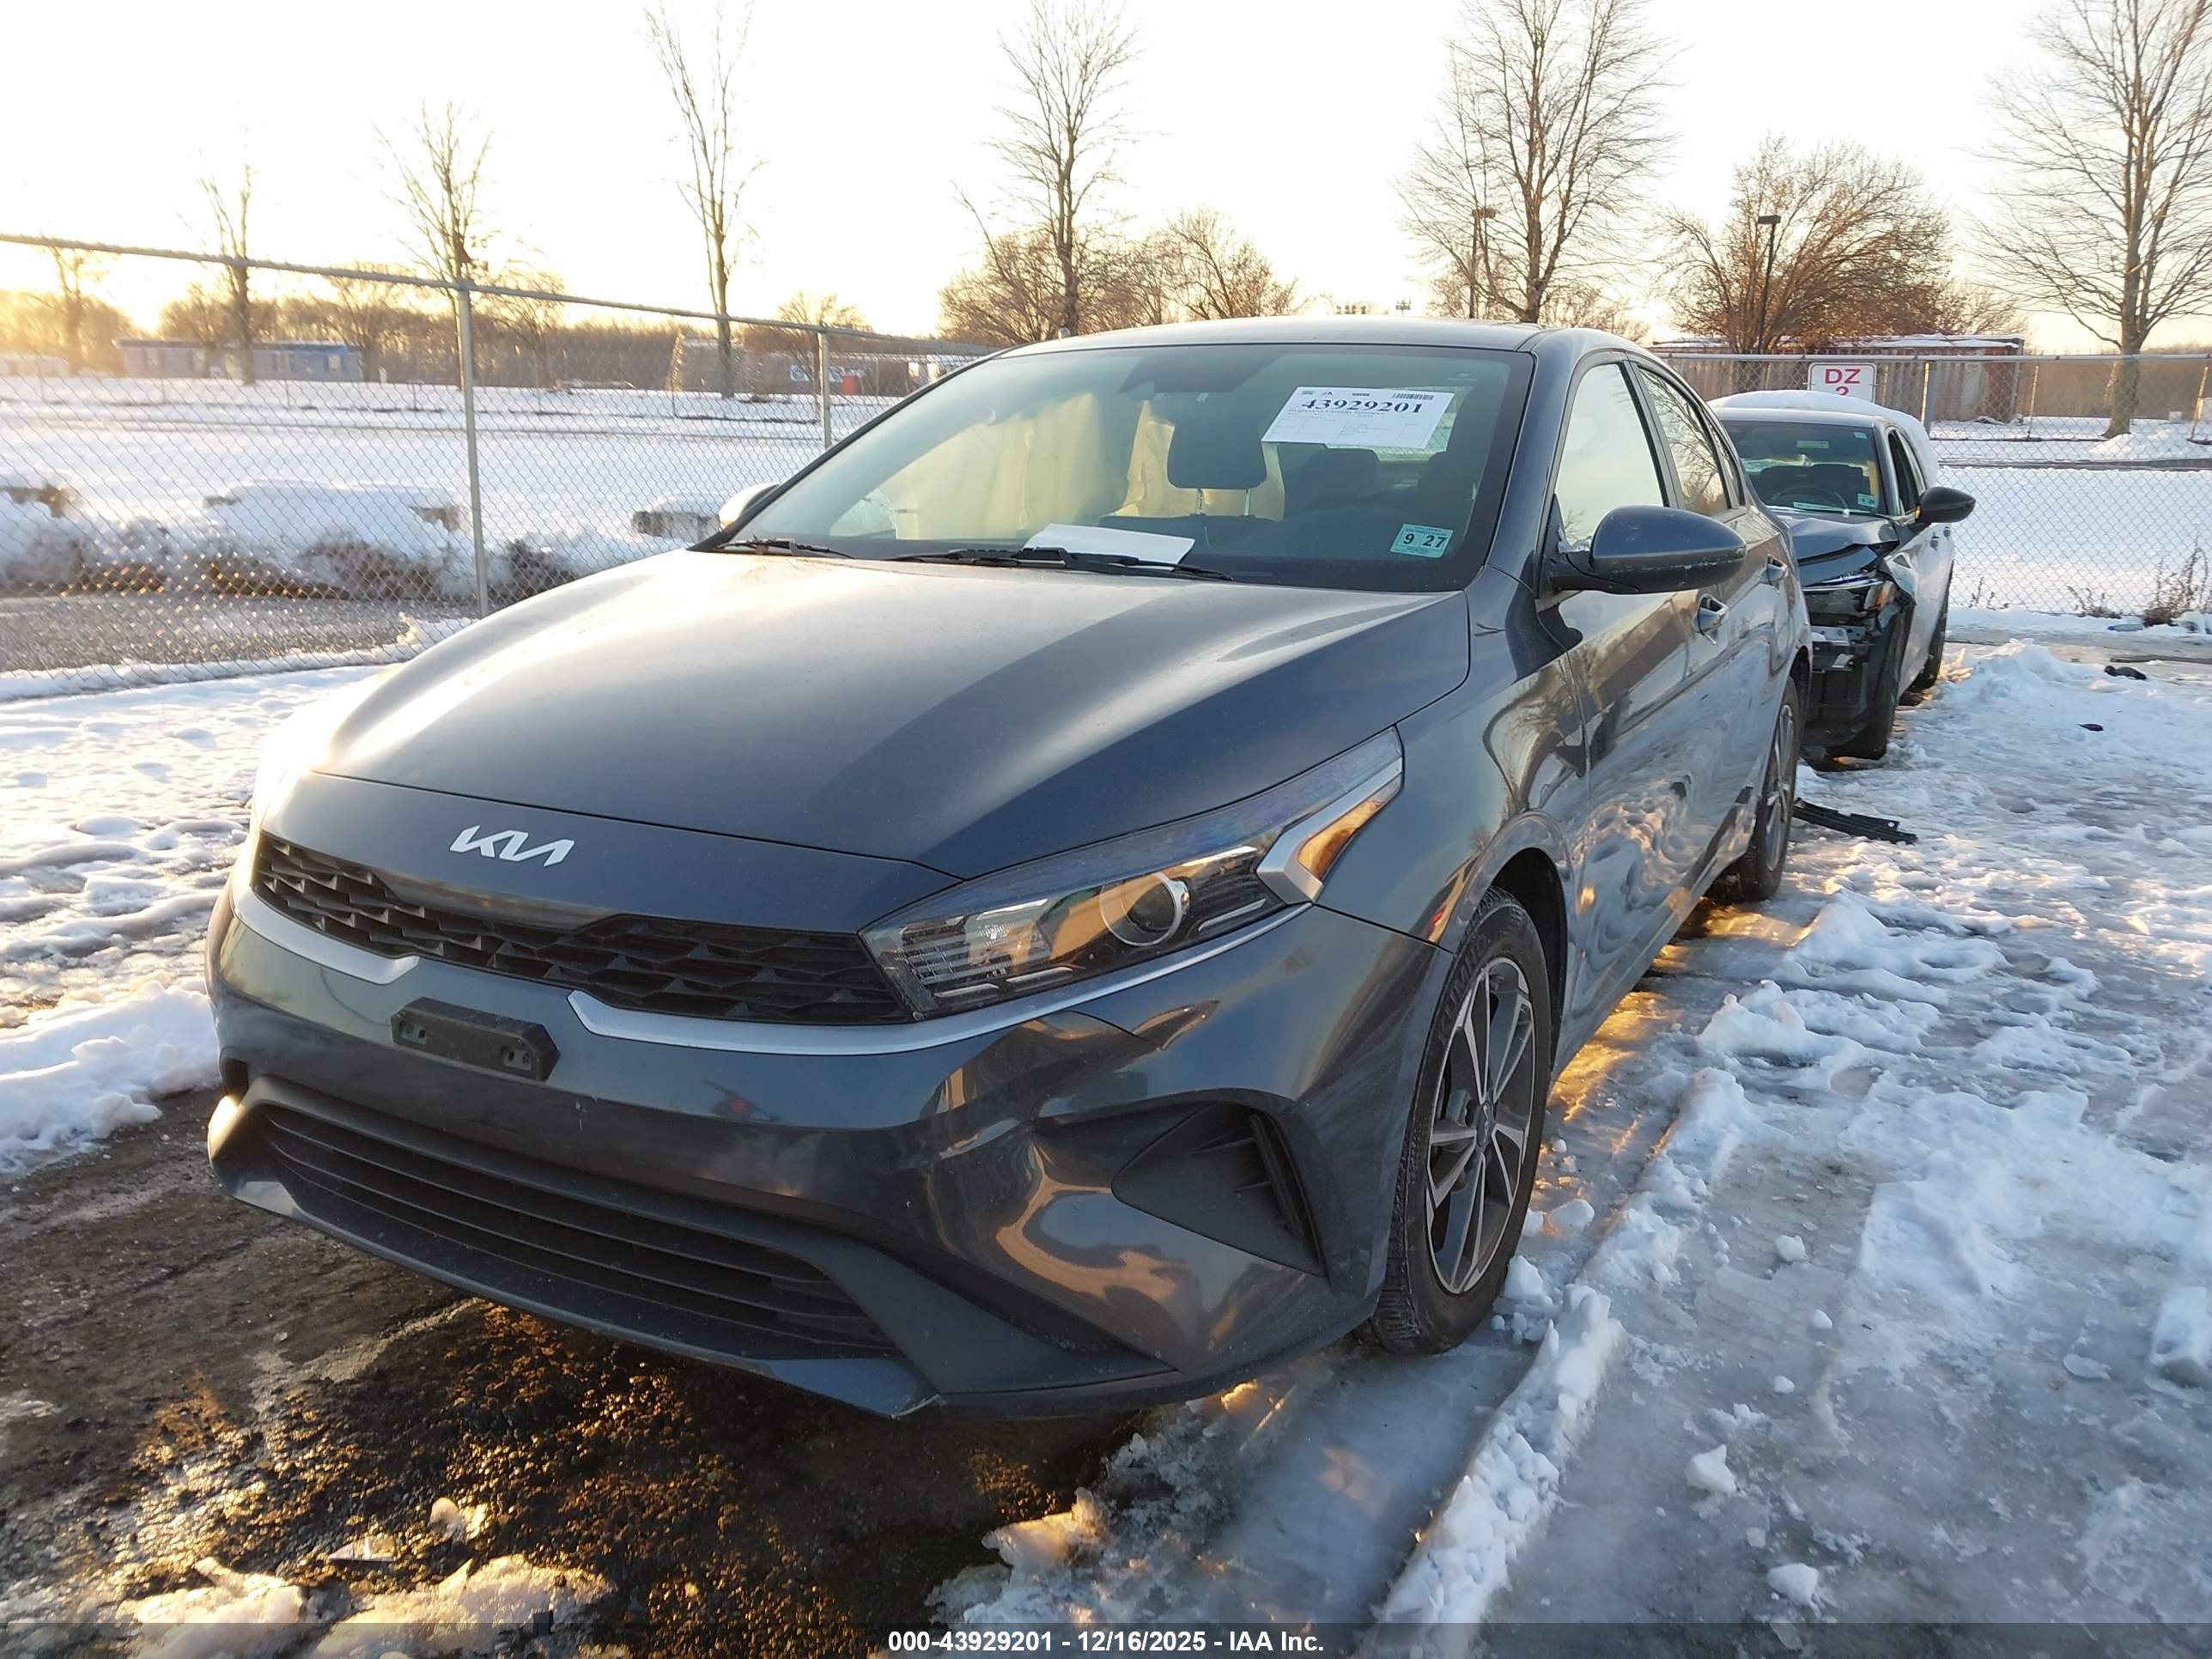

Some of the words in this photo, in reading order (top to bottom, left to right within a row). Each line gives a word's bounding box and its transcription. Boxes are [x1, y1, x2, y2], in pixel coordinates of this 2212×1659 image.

[1825, 368, 1862, 384] DZ
[1300, 398, 1423, 413] 43929201
[1403, 532, 1415, 544] 9
[1422, 535, 1448, 548] 27
[449, 824, 575, 867] KIA
